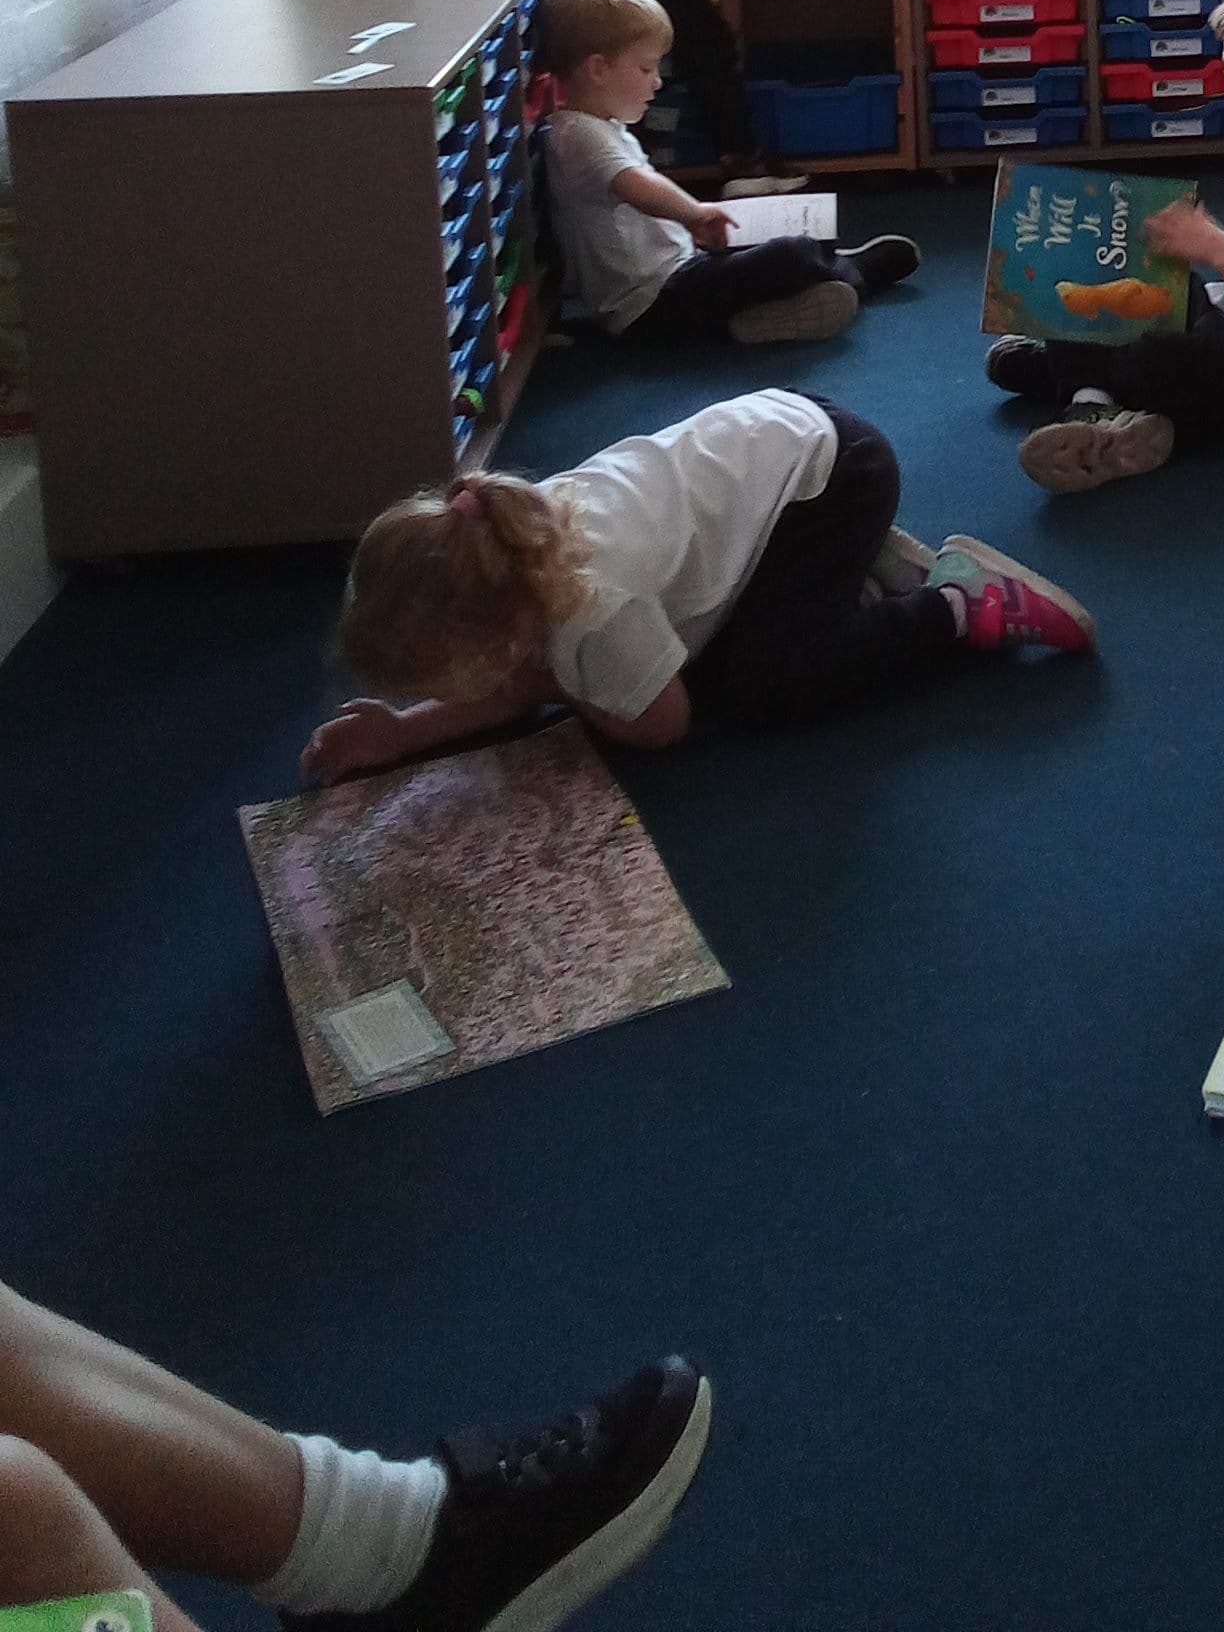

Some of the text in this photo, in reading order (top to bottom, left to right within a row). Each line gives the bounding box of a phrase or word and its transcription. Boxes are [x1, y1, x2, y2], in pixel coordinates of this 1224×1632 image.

[1013, 184, 1044, 252] When
[1044, 193, 1078, 250] Will
[1096, 180, 1131, 270] Snow?
